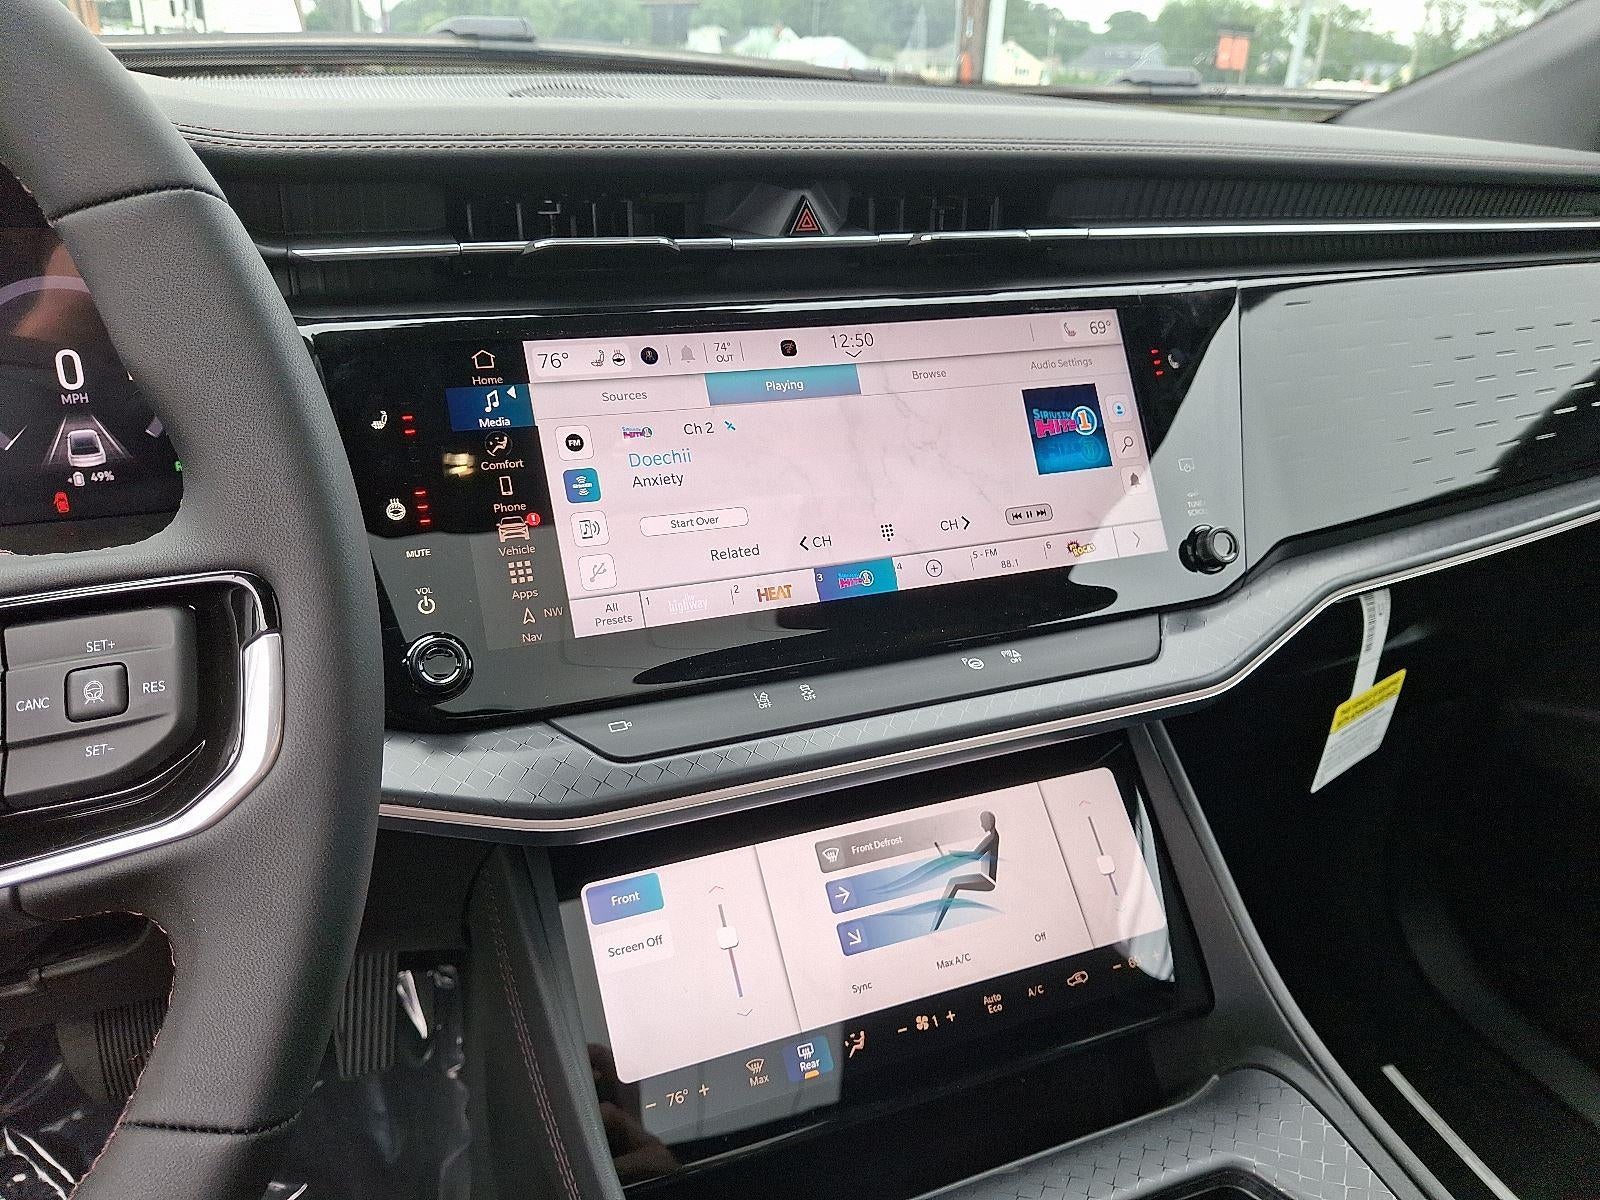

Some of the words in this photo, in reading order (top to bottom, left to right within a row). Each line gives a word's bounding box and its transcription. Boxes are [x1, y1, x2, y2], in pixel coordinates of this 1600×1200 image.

[1089, 320, 1111, 335] 69°
[713, 342, 731, 352] 74°
[831, 332, 874, 350] 12:50
[537, 352, 569, 369] 76°
[715, 353, 734, 363] OUT
[1030, 360, 1057, 371] Audio
[1058, 357, 1093, 371] Settings
[55, 349, 85, 390] 0
[912, 367, 947, 380] Browse
[472, 375, 504, 386] Home
[765, 379, 804, 393] Playing
[61, 393, 89, 404] MPH
[601, 389, 648, 403] Sources
[479, 417, 511, 428] Media
[684, 424, 702, 435] Ch
[705, 422, 715, 434] 2
[567, 438, 581, 447] FM
[628, 448, 692, 467] Doechii
[480, 458, 524, 471] Comfort
[90, 471, 115, 482] 49%
[632, 473, 684, 489] Anxiety
[493, 502, 527, 513] Phone
[670, 518, 694, 529] Start
[696, 515, 720, 526] Over
[940, 519, 959, 531] CH
[812, 536, 832, 548] CH
[1046, 541, 1052, 550] 6
[405, 548, 431, 558] MUTE
[498, 544, 536, 556] Vehicle
[710, 544, 761, 561] Related
[1001, 558, 1020, 569] 88.1
[816, 573, 824, 582] 3
[415, 587, 433, 595] VOL
[511, 588, 539, 600] Apps
[733, 584, 740, 594] 2
[756, 584, 793, 603] HEAT
[543, 606, 564, 618] NW
[605, 602, 618, 613] All
[595, 614, 633, 627] Presets
[522, 632, 543, 643] Nav
[86, 640, 115, 652] SET+
[142, 681, 166, 693] RES
[16, 698, 50, 711] CANC
[851, 842, 873, 855] Front
[874, 835, 903, 850] Defrost
[611, 891, 641, 905] Front
[1035, 931, 1047, 943] Off
[608, 940, 645, 957] Screen
[647, 935, 663, 949] Off
[936, 960, 955, 971] Max
[955, 953, 971, 965] A/C
[851, 981, 873, 994] Sync
[1028, 985, 1044, 998] A/C
[983, 994, 1002, 1006] Auto
[987, 1004, 1003, 1015] Eco
[932, 1015, 938, 1027] 1
[800, 1060, 820, 1071] Rear
[750, 1075, 769, 1087] Max
[666, 1089, 690, 1107] 76°
